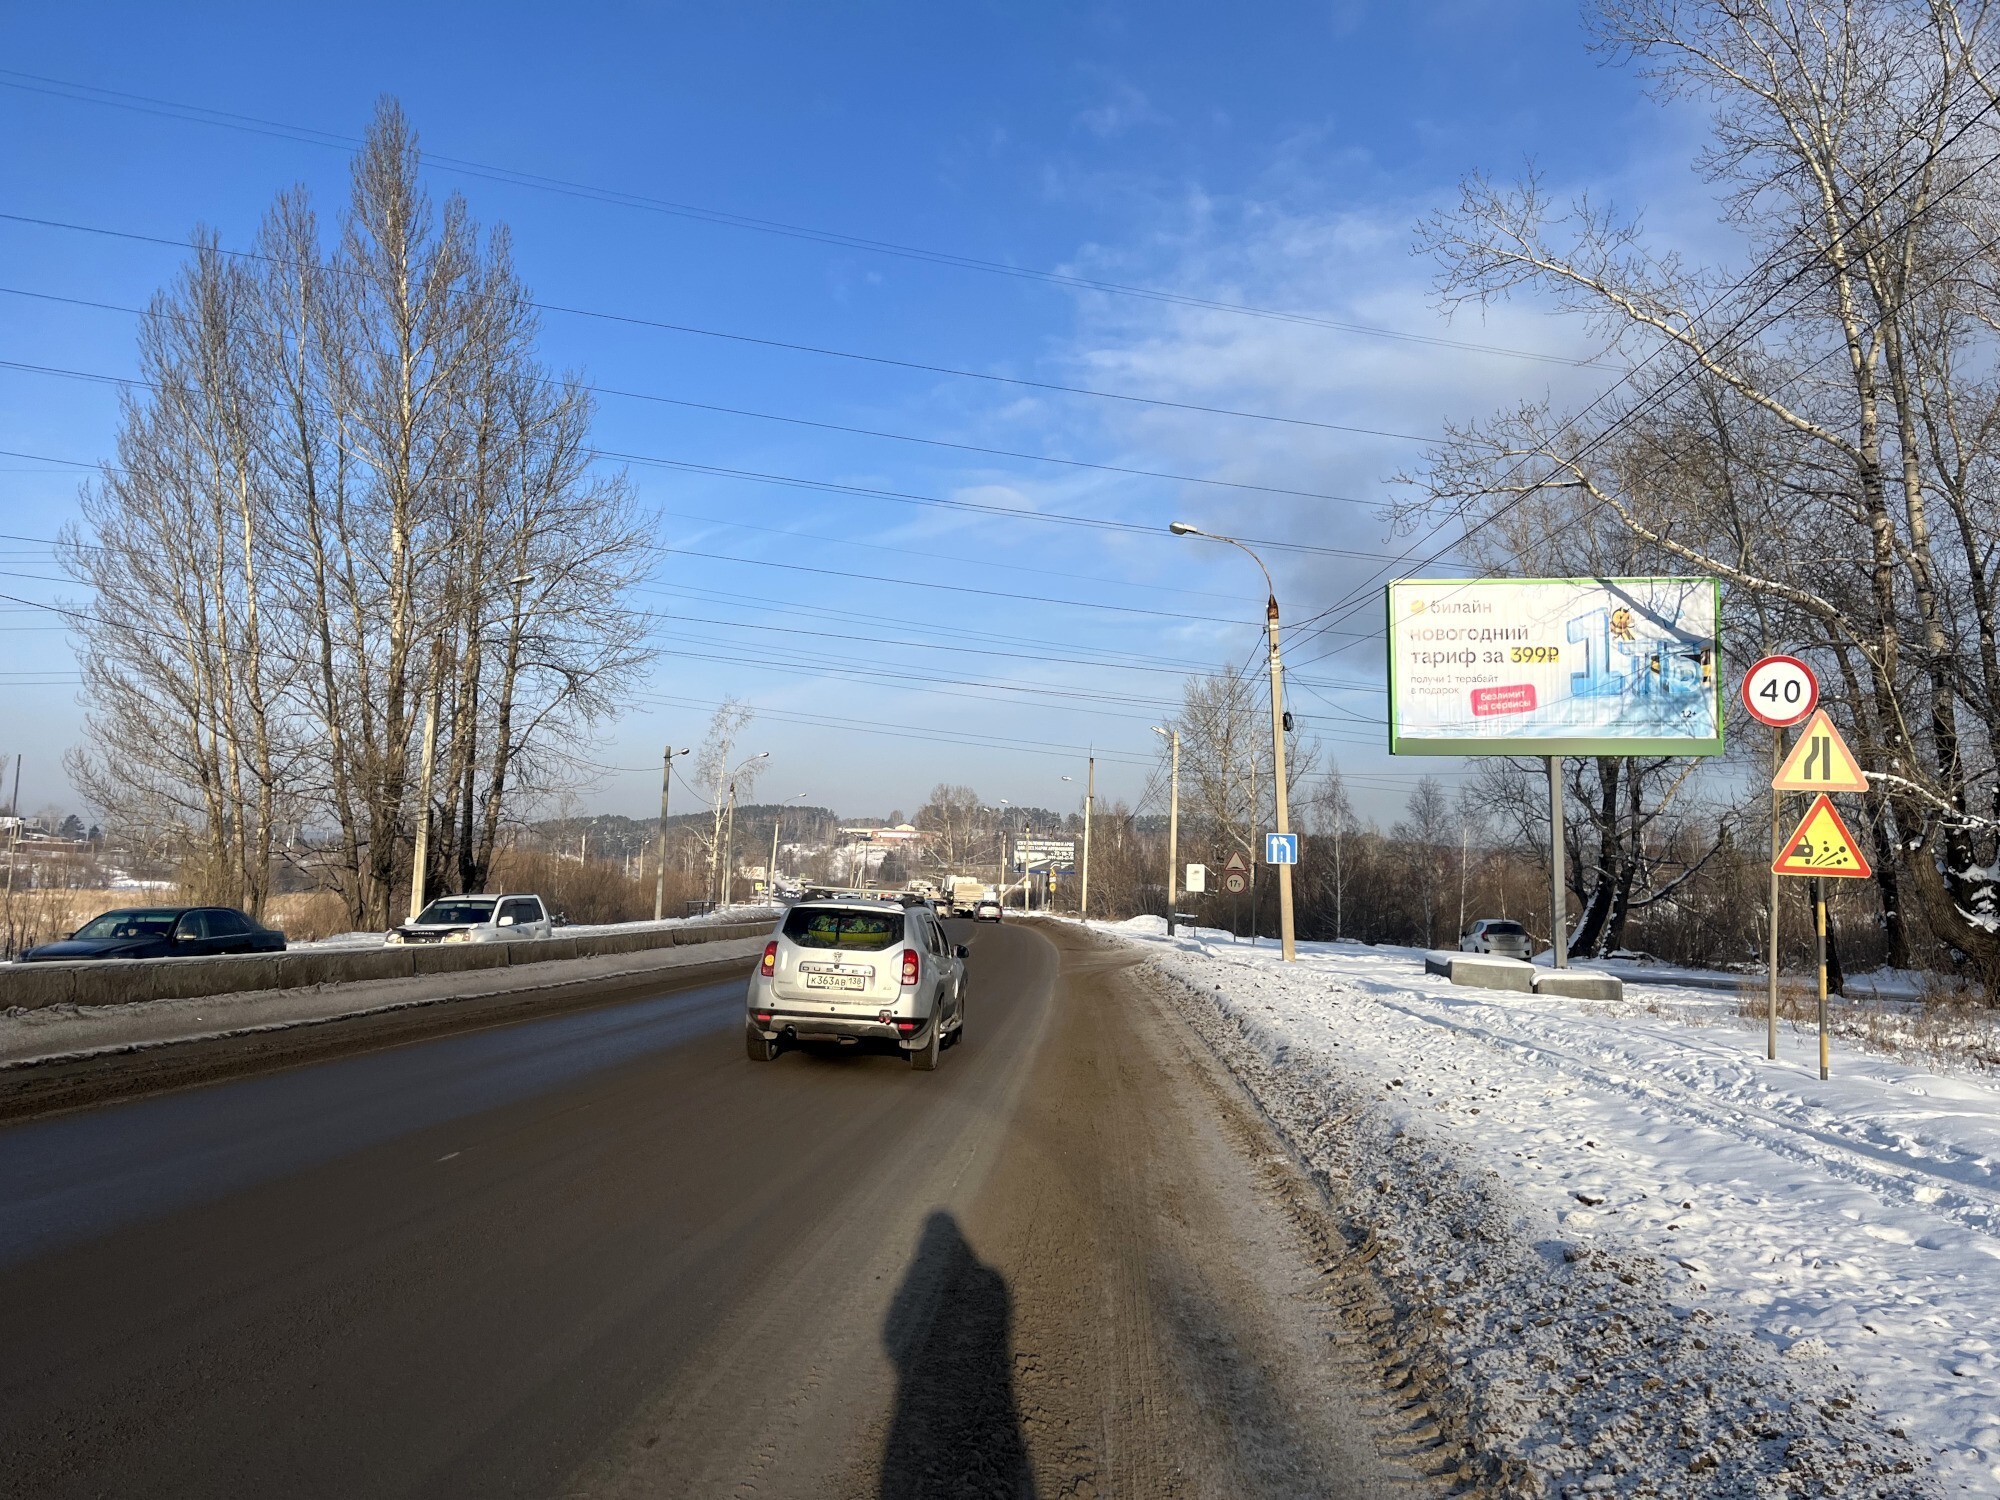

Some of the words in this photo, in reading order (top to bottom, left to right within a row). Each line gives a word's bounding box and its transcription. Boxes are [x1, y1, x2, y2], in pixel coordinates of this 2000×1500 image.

[1430, 600, 1492, 614] билайн
[1410, 624, 1529, 643] новогодний
[1410, 647, 1477, 668] тариф
[1483, 652, 1504, 664] за
[1410, 676, 1445, 685] получи
[1447, 675, 1451, 683] 1
[1455, 674, 1499, 684] терабайт
[1419, 687, 1460, 696] подарок
[1480, 690, 1526, 701] безлимит
[1759, 678, 1801, 704] 40
[1477, 703, 1489, 712] на
[1490, 698, 1532, 711] сервисы
